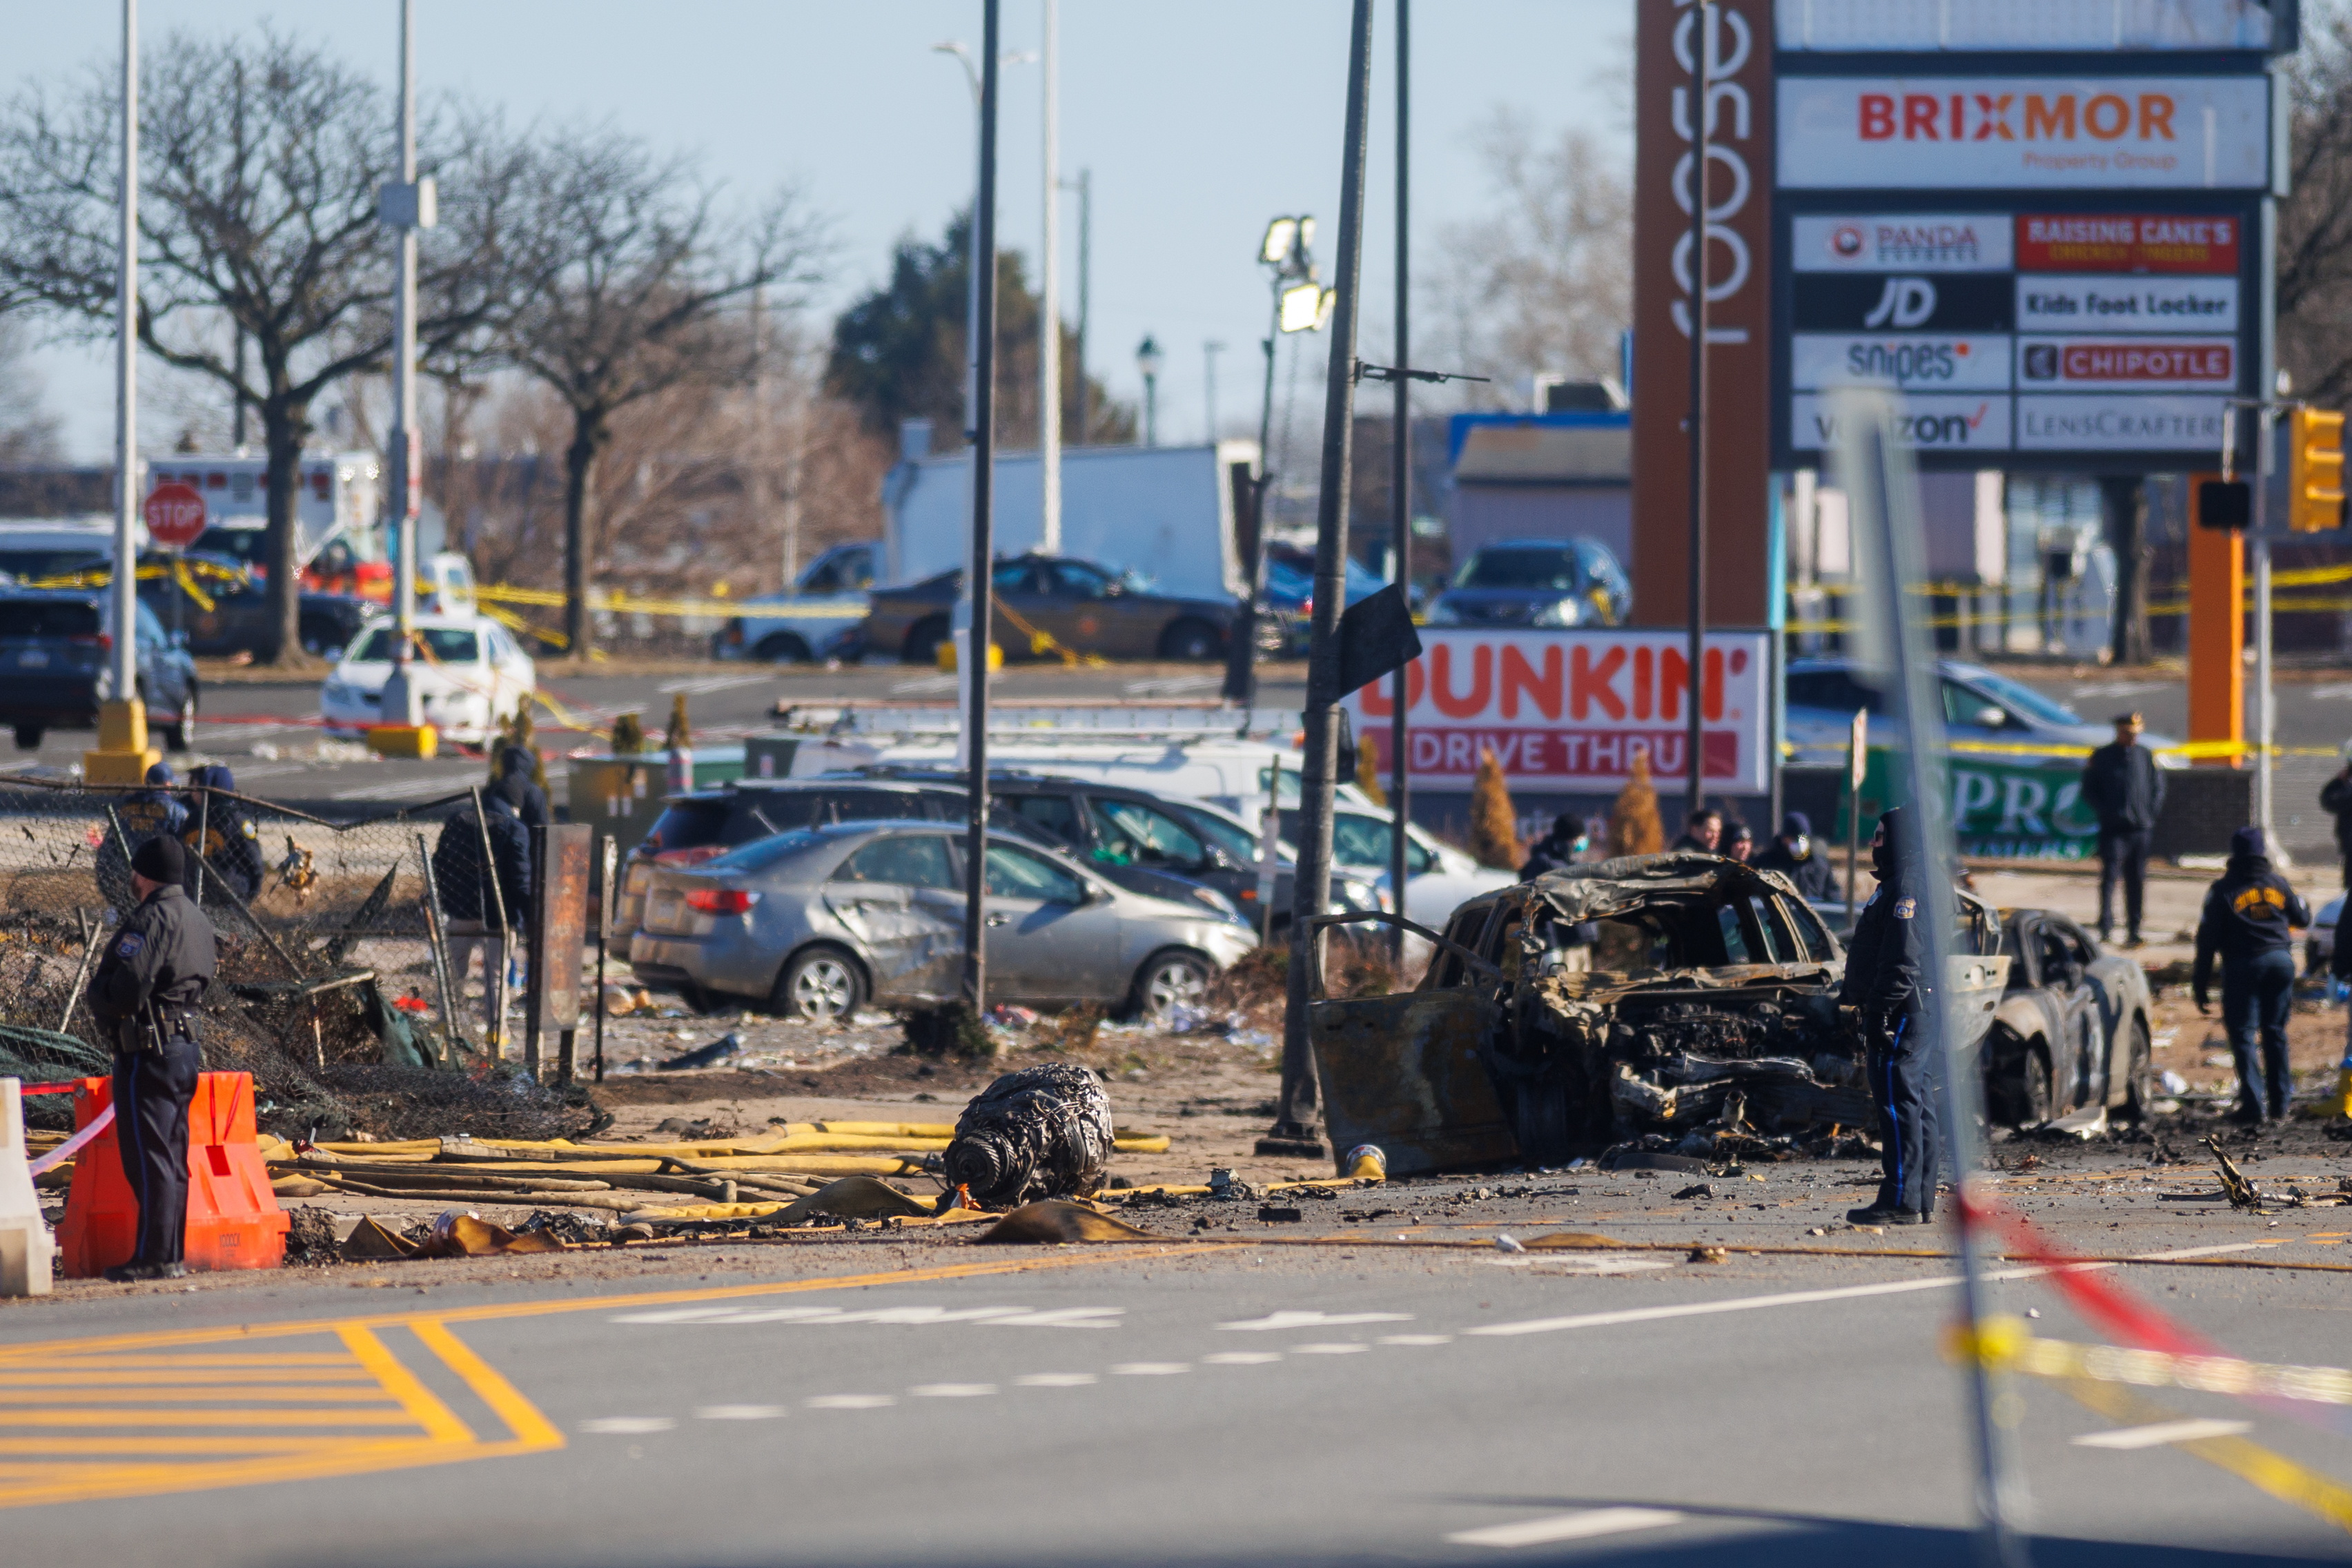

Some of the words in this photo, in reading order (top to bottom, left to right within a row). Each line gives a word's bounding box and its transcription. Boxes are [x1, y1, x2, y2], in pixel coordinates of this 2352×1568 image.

[1859, 93, 2176, 141] BRIXMOR
[1670, 0, 1752, 344] roose
[2022, 151, 2106, 171] Property
[2113, 150, 2179, 171] Group
[1876, 225, 1979, 248] PANDA
[2028, 221, 2134, 243] RAISING
[2140, 222, 2231, 245] CANE'S
[1865, 277, 1937, 328] JD
[2026, 292, 2077, 315] Kids
[2086, 292, 2138, 315] Foot
[2146, 292, 2227, 315] Locker
[1848, 342, 1954, 387] snipes
[2069, 350, 2224, 375] CHIPOTLE
[1814, 406, 1968, 444] vzon
[146, 504, 201, 527] STOP
[1413, 732, 1544, 771] DRIVE
[1560, 734, 1684, 772] THRU
